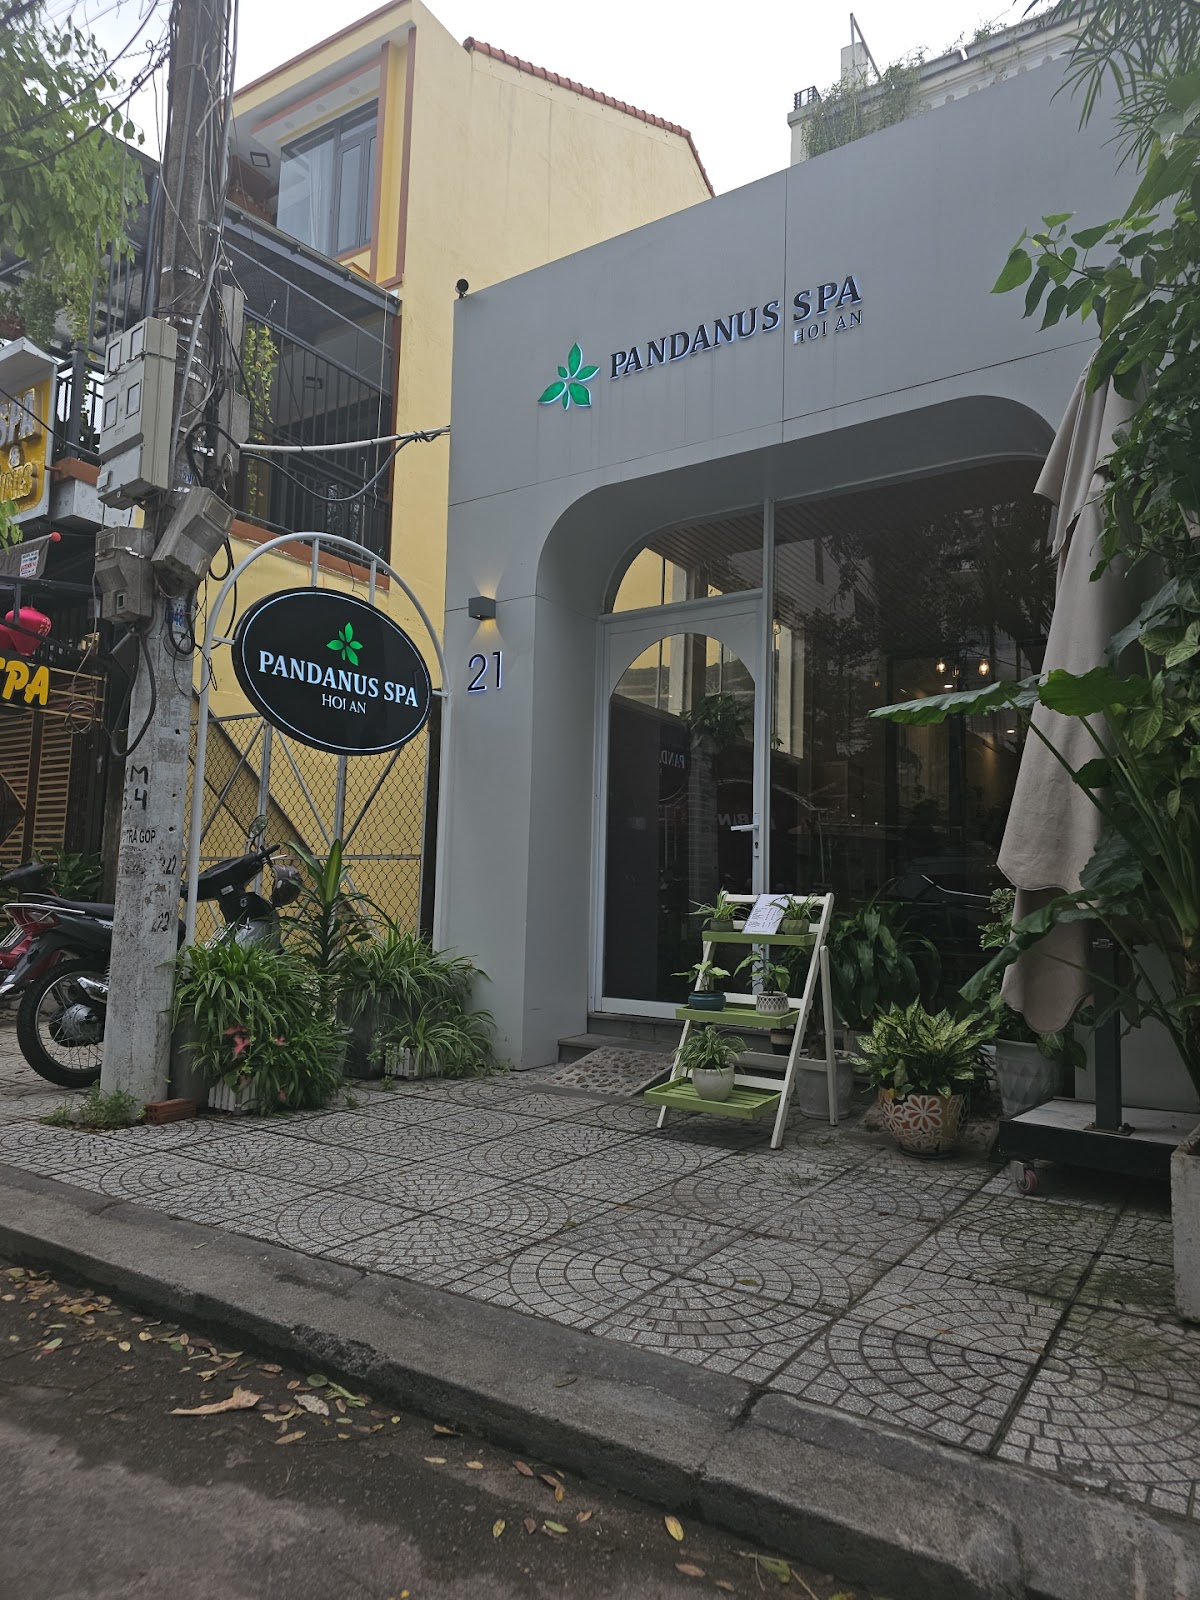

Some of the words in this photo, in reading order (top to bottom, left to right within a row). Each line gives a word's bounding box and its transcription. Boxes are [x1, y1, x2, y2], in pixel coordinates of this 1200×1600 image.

[608, 299, 781, 380] PANDANUS
[792, 275, 863, 322] SPA
[792, 320, 828, 345] HOI
[834, 310, 863, 332] AN
[258, 650, 379, 698] PANDANUS
[383, 681, 419, 708] SPA
[467, 650, 503, 692] 21
[321, 693, 347, 710] HOI
[349, 701, 367, 714] AN
